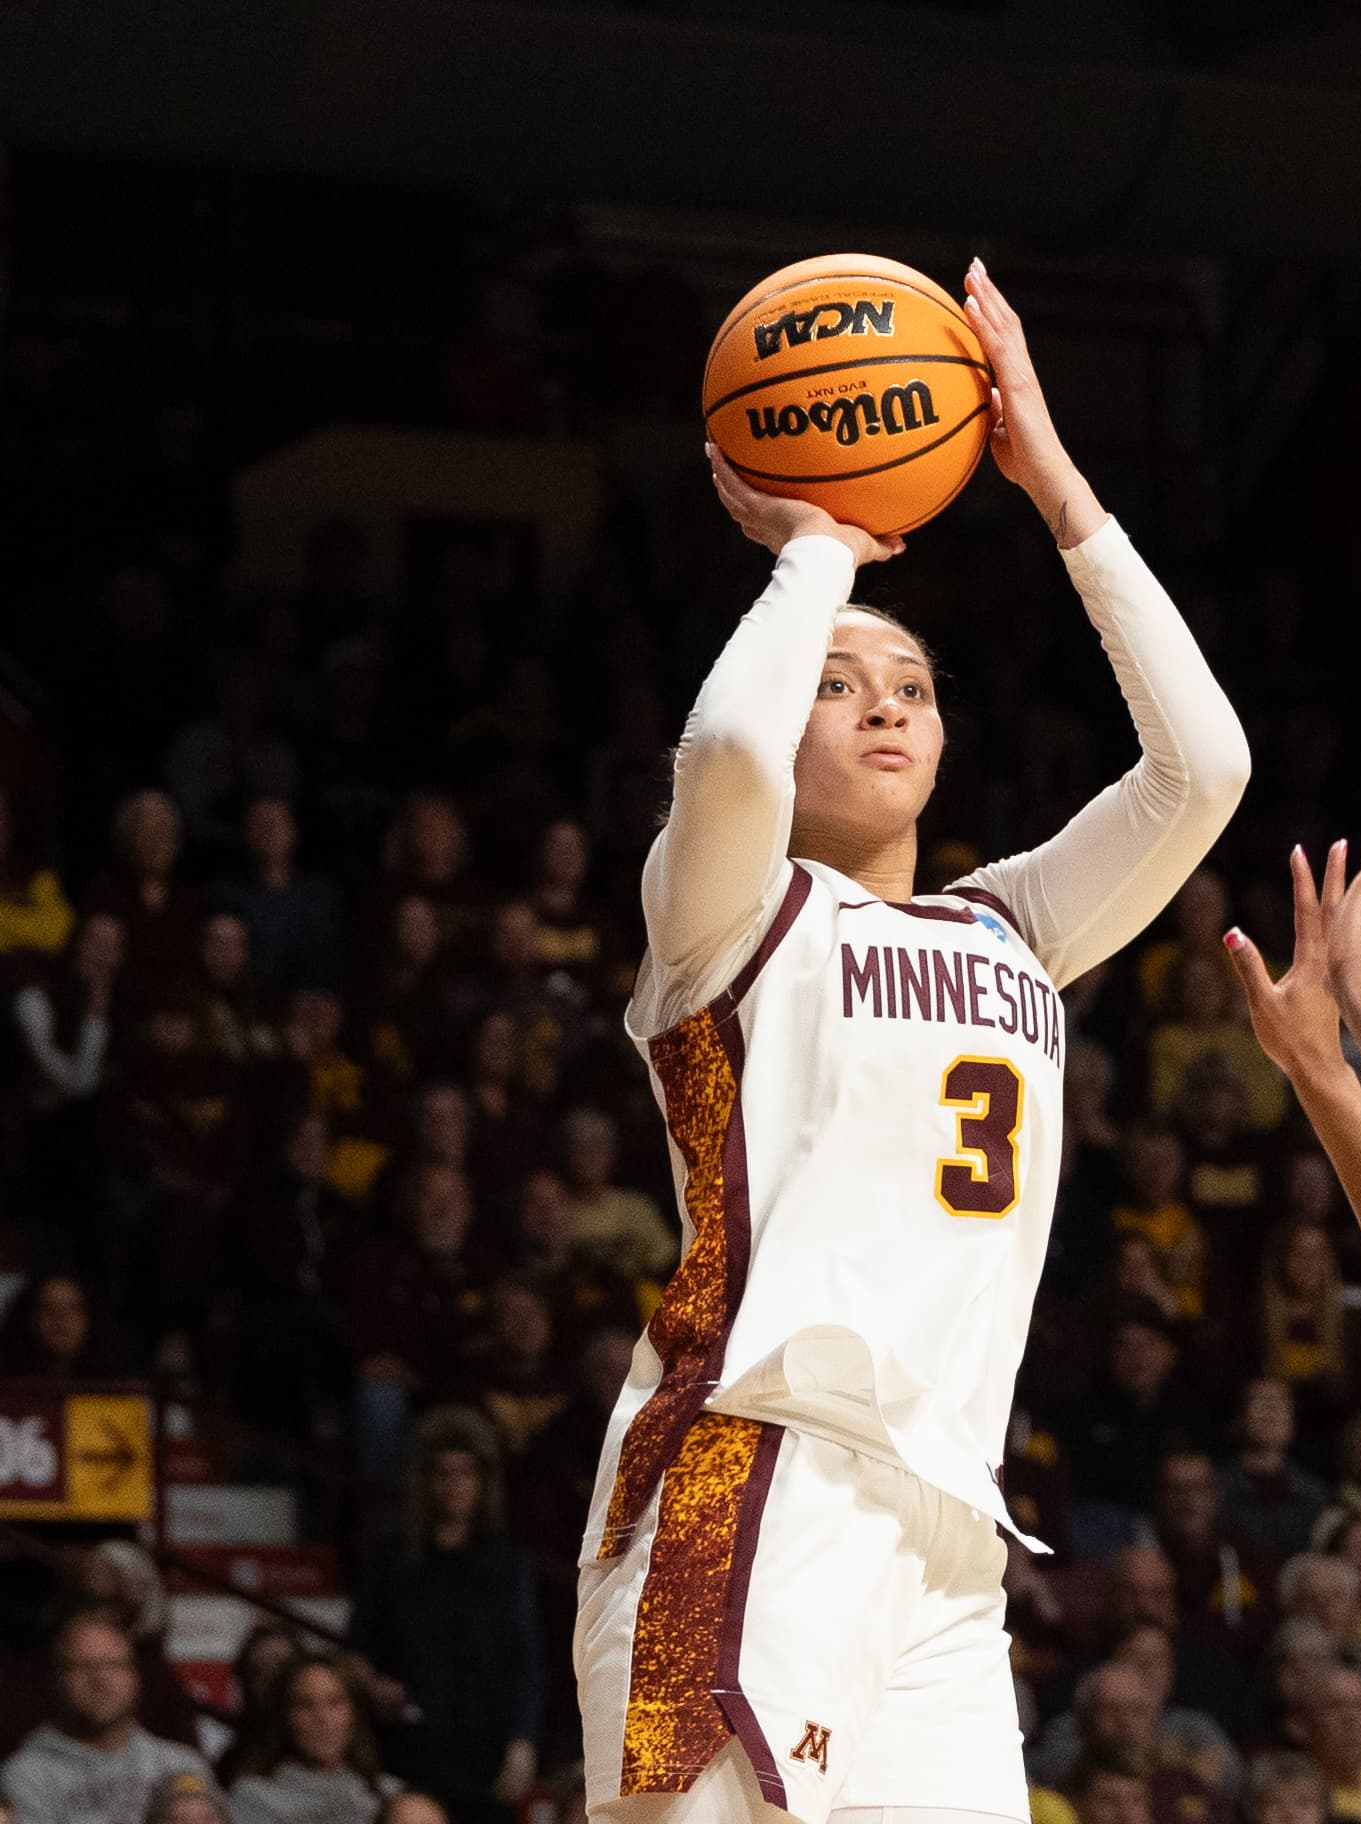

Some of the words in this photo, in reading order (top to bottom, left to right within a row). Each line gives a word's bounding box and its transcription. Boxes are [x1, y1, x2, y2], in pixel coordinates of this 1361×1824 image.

[754, 299, 895, 361] NCAA
[745, 378, 940, 446] Wilson
[806, 387, 834, 399] NXT
[839, 380, 867, 393] EVO
[840, 943, 1061, 1069] MINNESOTA
[934, 1054, 1025, 1219] 3
[790, 1720, 832, 1775] M
